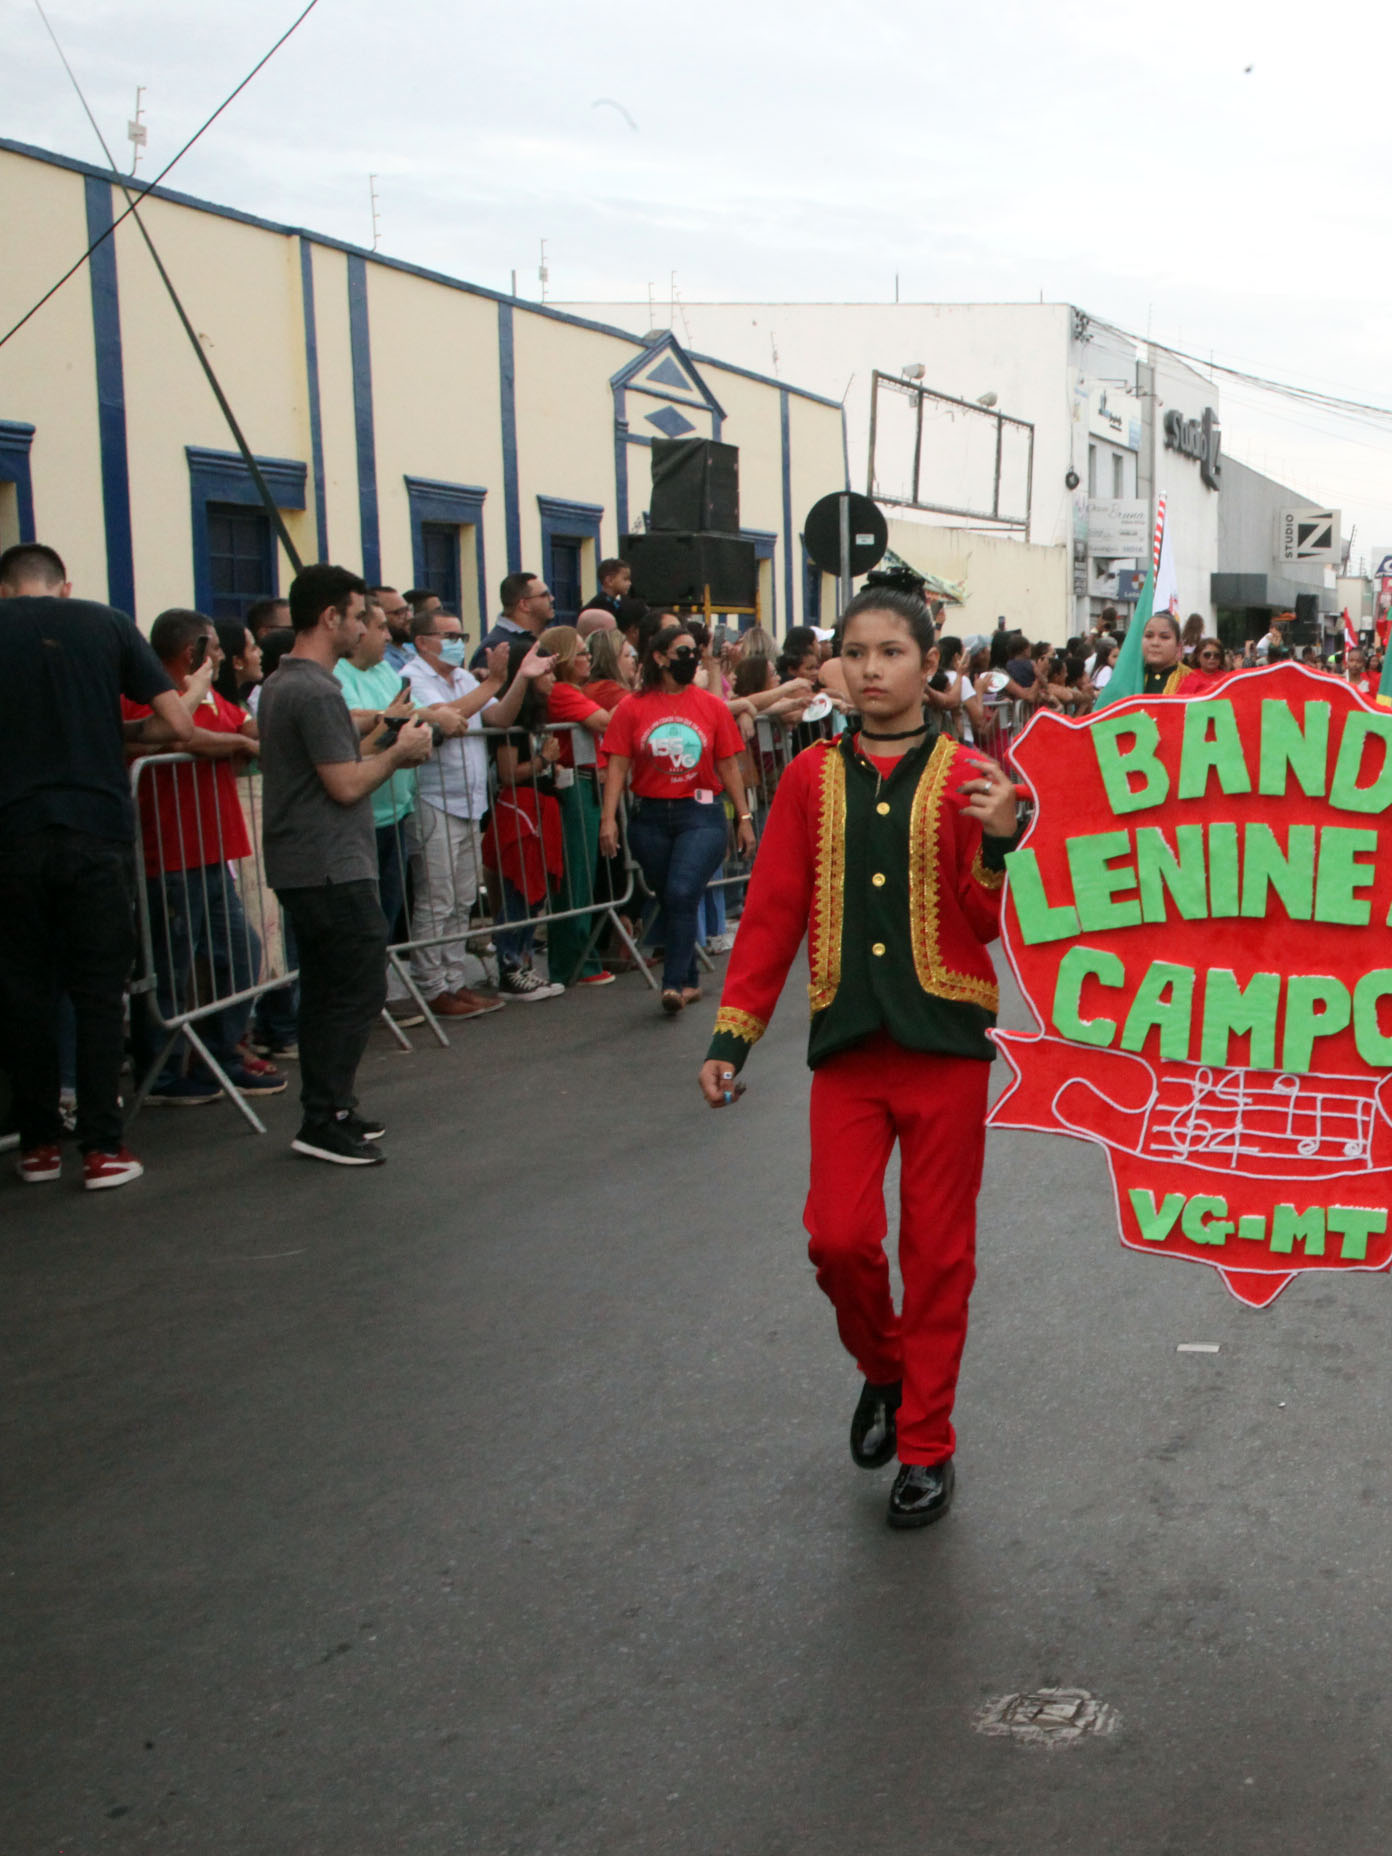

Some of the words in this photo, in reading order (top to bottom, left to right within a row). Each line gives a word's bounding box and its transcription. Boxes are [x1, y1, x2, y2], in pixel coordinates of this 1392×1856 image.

[1163, 409, 1208, 463] Studio
[1284, 513, 1295, 559] STUDIO
[669, 754, 696, 768] VG
[1004, 822, 1378, 945] LENINE
[1128, 1189, 1388, 1260] VG-MT
